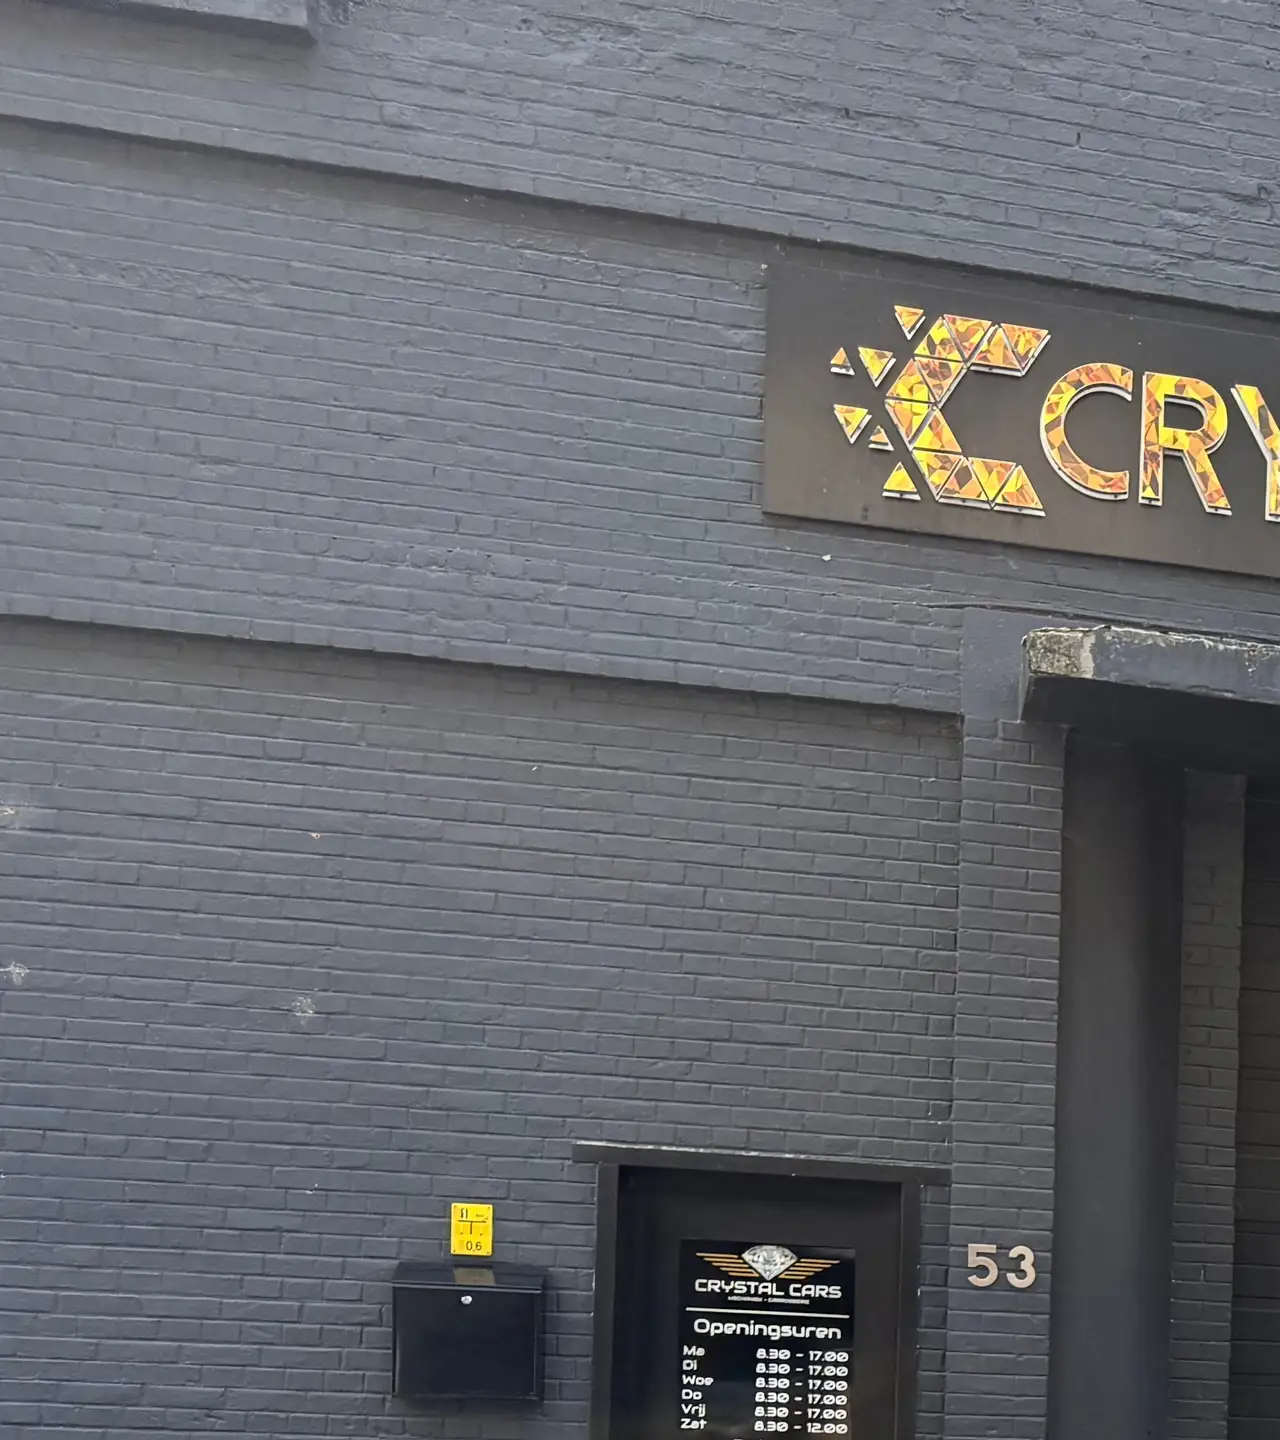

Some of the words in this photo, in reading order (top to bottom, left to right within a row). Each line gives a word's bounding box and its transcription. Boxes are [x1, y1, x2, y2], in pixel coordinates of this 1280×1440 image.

[967, 1243, 1036, 1289] 53
[694, 1278, 785, 1297] CRYSTAL
[788, 1283, 842, 1299] CARS
[693, 1318, 842, 1340] Openingsuren
[683, 1345, 705, 1357] Ma
[756, 1348, 791, 1360] 8.30
[808, 1350, 849, 1363] 17.00
[682, 1359, 698, 1371] Di
[755, 1363, 791, 1374] 8.30
[808, 1365, 849, 1377] 17.00
[682, 1374, 714, 1386] Woe
[755, 1377, 790, 1389] 8.30
[808, 1380, 848, 1391] 17.00
[681, 1389, 703, 1400] Do
[754, 1391, 790, 1403] 8.30
[807, 1394, 848, 1405] 17.00
[681, 1403, 706, 1417] Vrij
[754, 1406, 789, 1418] 8.30
[807, 1408, 847, 1420] 17.00
[680, 1418, 707, 1429] Zat
[754, 1421, 789, 1432] 8.30
[806, 1422, 848, 1434] 12.00
